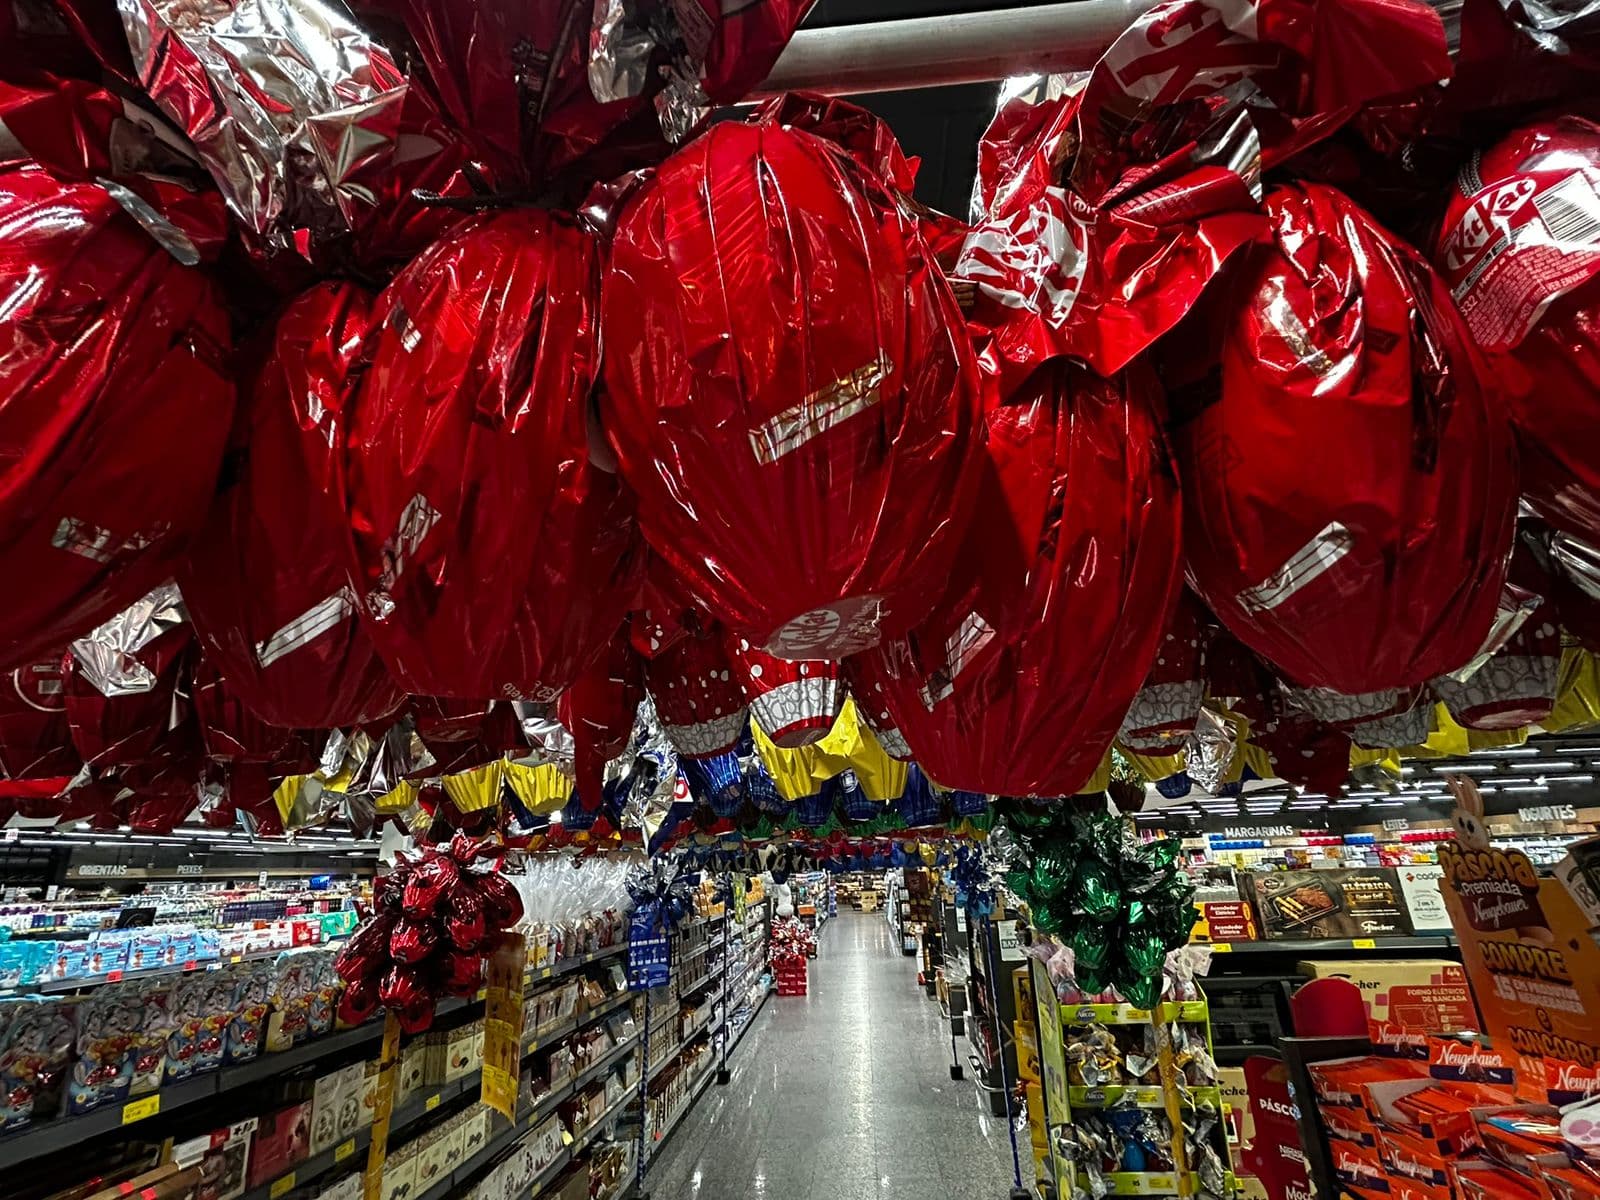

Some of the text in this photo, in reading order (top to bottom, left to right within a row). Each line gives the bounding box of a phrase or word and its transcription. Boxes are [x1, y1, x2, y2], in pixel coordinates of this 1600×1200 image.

[1450, 180, 1534, 268] KitKat
[1518, 804, 1577, 822] IOGURTES
[1224, 825, 1294, 838] MARGARINAS
[78, 864, 128, 876] ORIENTAIS
[1462, 878, 1523, 897] Premiada
[1473, 897, 1529, 928] Neugebauer
[1478, 942, 1568, 975] COMPRE
[1377, 1024, 1426, 1053] Neugebauer
[1436, 1043, 1503, 1075] Neugebauer
